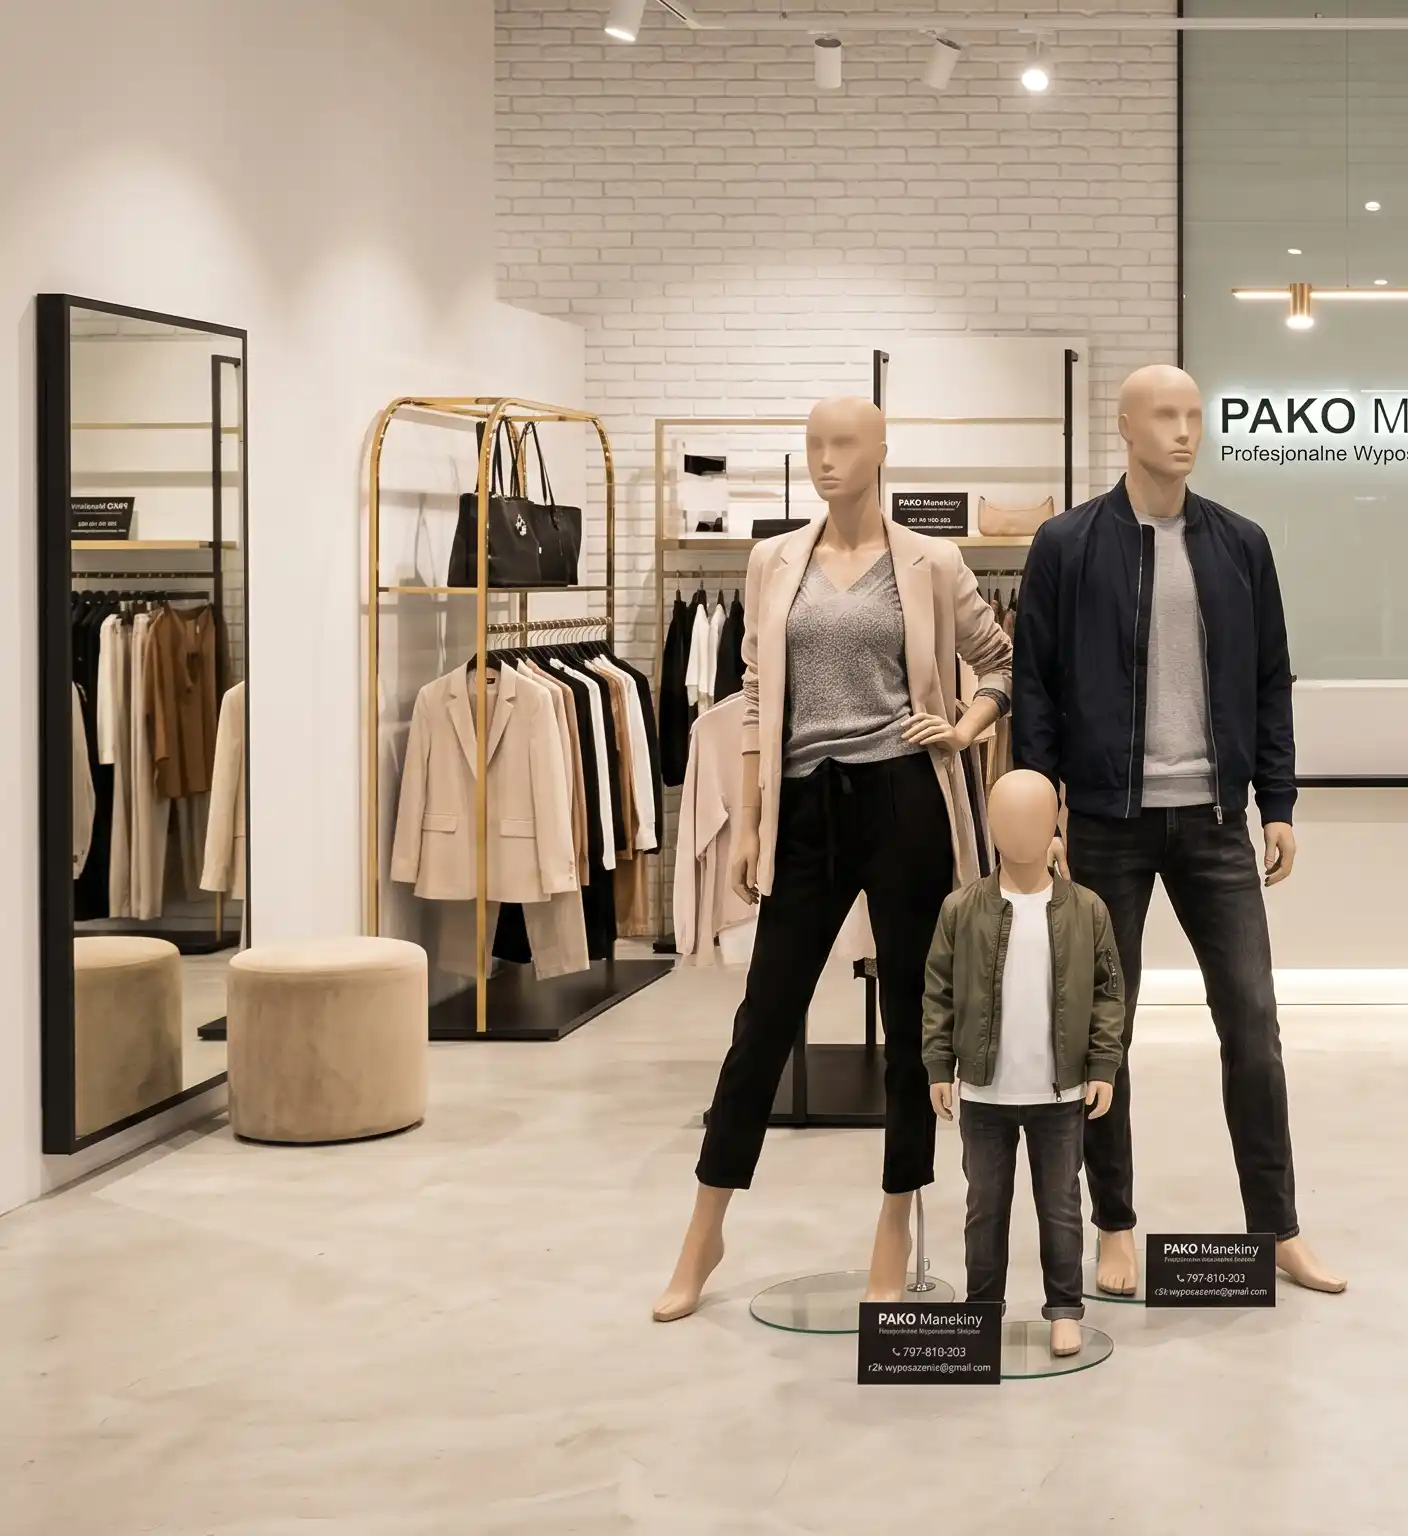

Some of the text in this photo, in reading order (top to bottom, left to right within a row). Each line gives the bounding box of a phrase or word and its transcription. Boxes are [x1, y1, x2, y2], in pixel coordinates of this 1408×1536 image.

[1220, 397, 1356, 434] PAKO
[1220, 445, 1348, 463] Profesjonalne
[898, 499, 922, 507] PAKO
[1163, 1243, 1260, 1257] PAKO Manekiny
[1186, 1273, 1246, 1284] 797-810-203
[878, 1312, 983, 1328] PAKO Manekiny
[902, 1346, 967, 1358] 797-810-203
